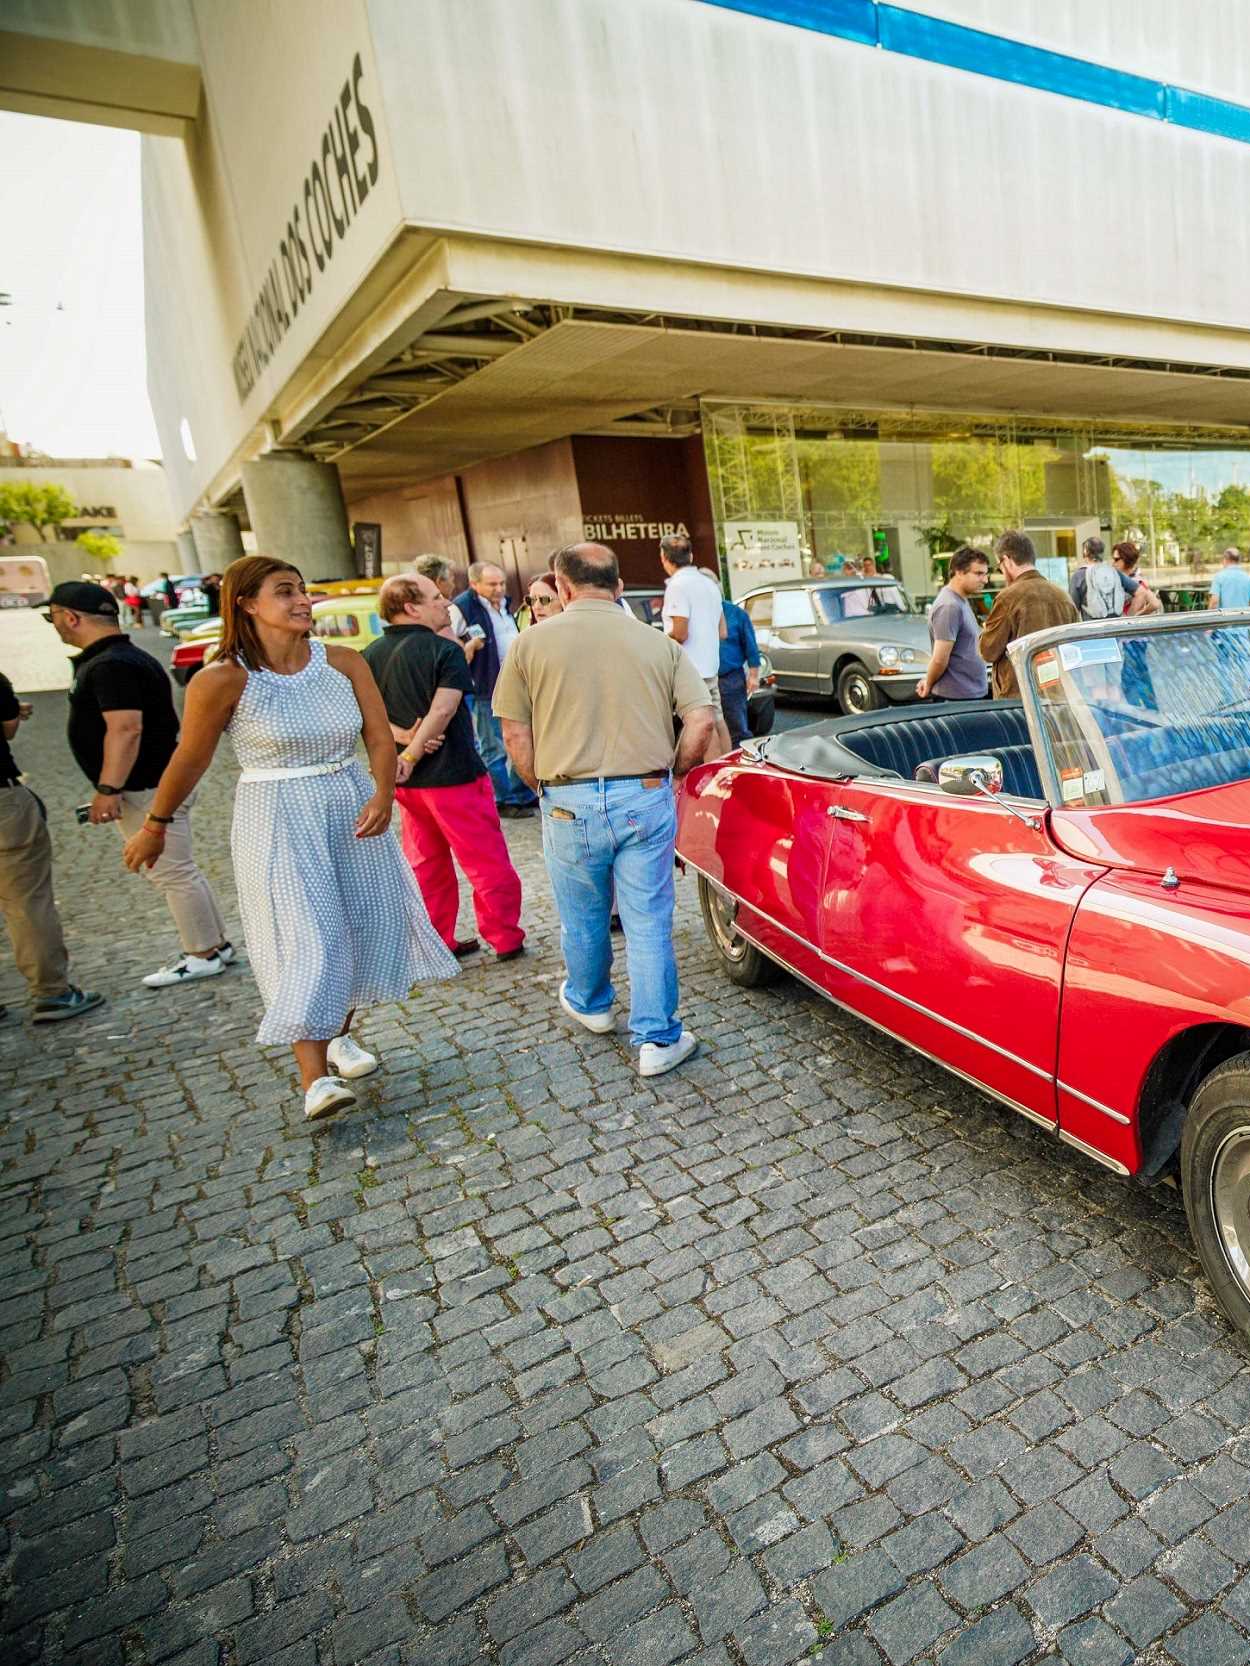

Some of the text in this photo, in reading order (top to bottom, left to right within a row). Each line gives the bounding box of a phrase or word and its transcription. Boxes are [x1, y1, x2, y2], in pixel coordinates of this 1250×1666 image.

[280, 203, 312, 318] DOS
[304, 52, 379, 273] COCHES
[583, 521, 690, 540] BILHETEIRA
